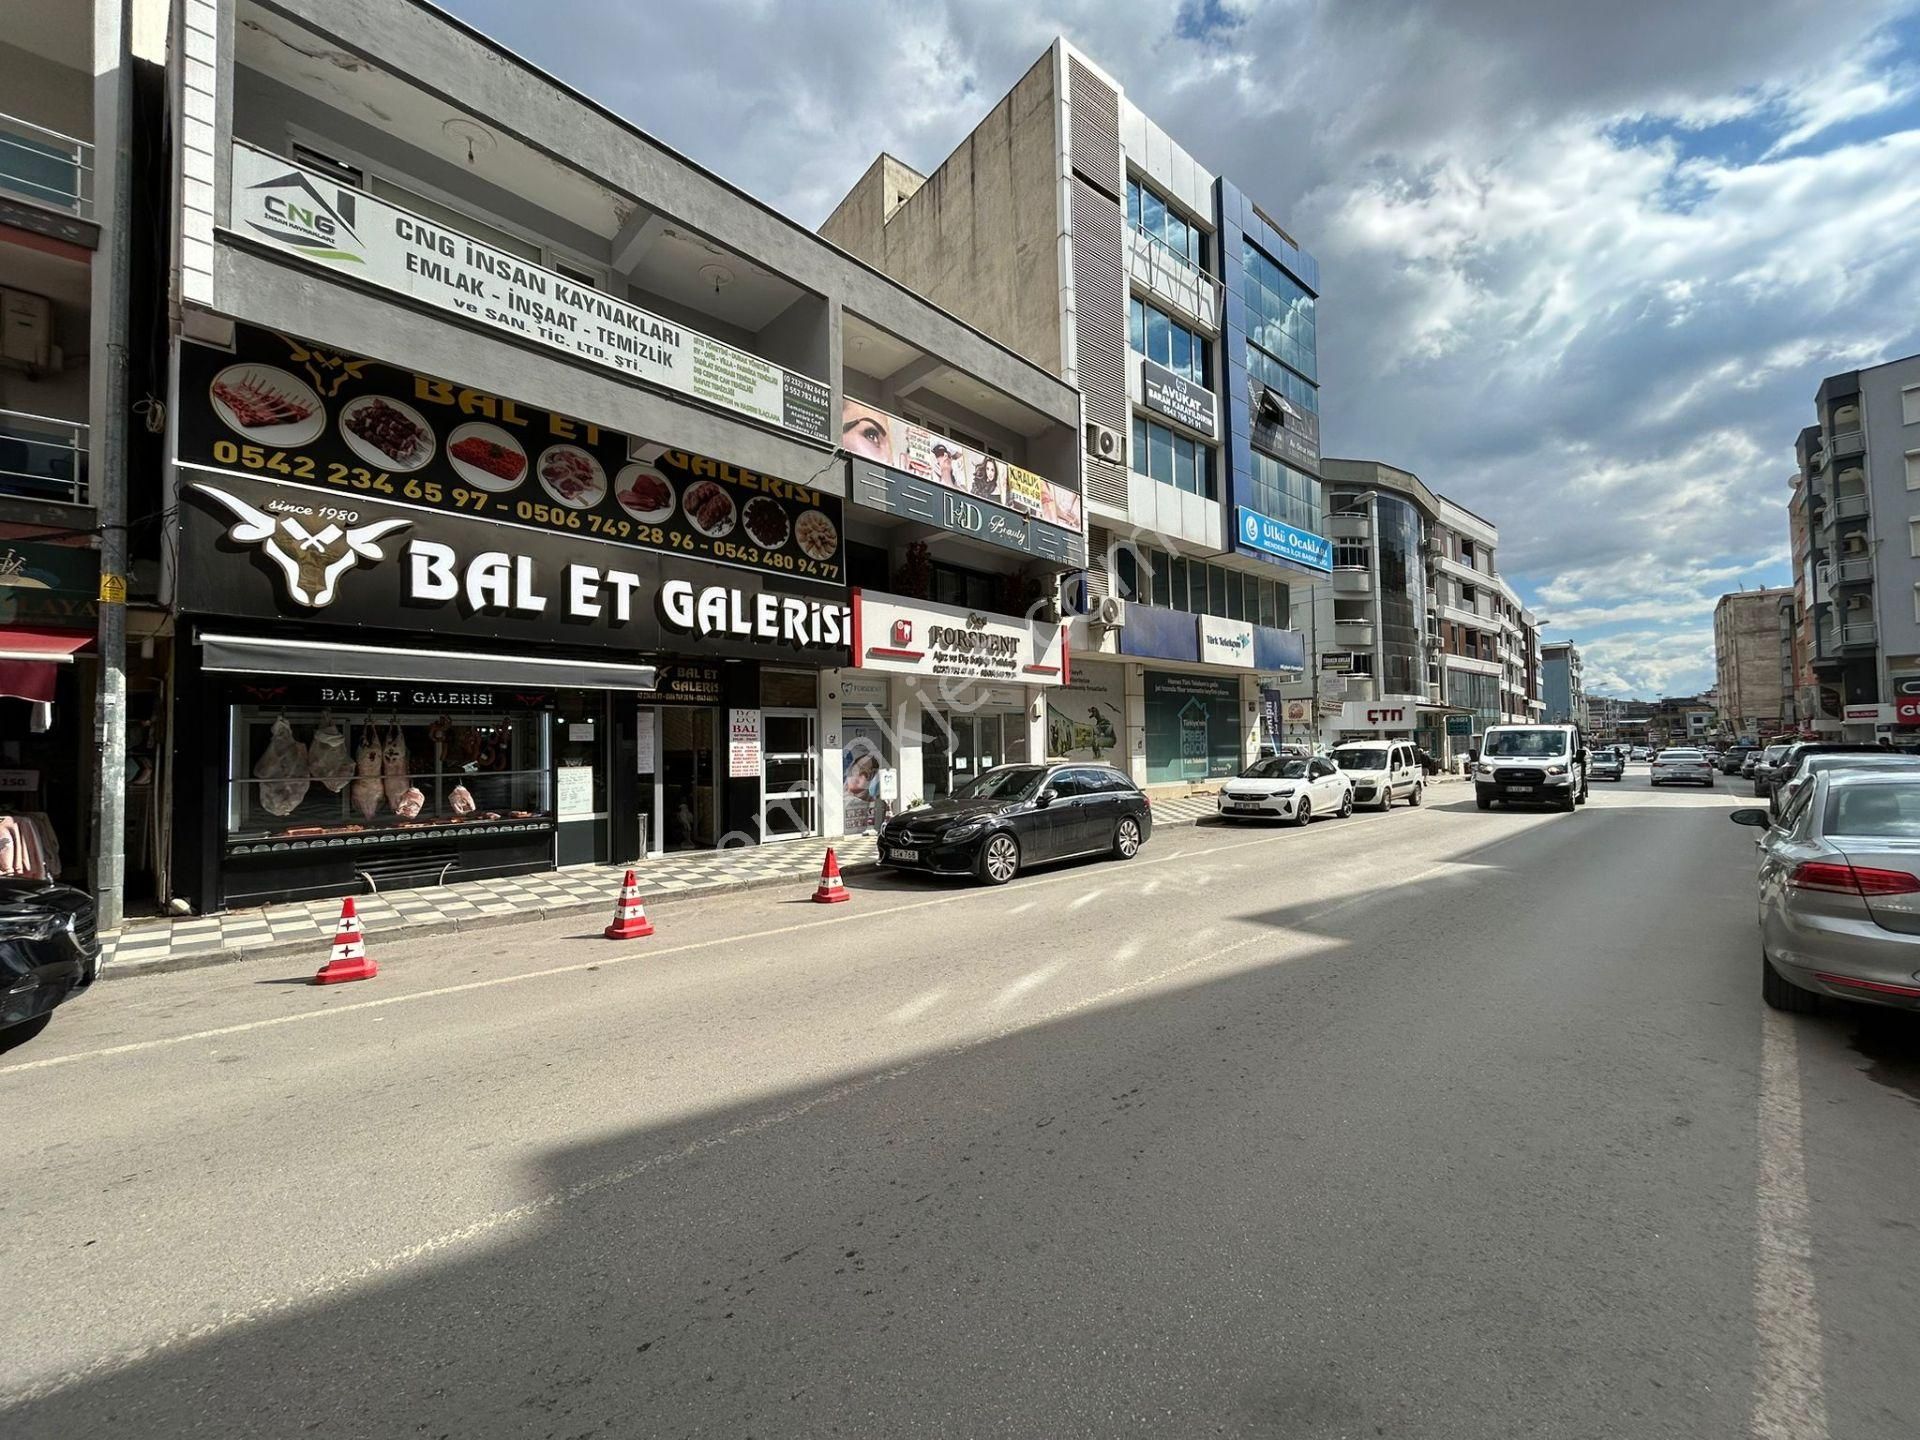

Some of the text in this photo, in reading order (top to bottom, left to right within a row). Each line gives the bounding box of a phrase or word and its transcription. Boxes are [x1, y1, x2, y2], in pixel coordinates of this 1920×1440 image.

[264, 195, 336, 236] CNG
[395, 217, 680, 348] CNG İNSAN KAYNAKLARI
[406, 252, 484, 299] EMLAK
[508, 287, 577, 332] İNŞAAT
[597, 326, 673, 369] TEMİZLİK
[453, 298, 478, 313] ve
[485, 307, 532, 333] SAN.
[577, 342, 608, 361] LTD.
[615, 354, 643, 373] ŞTİ.
[413, 375, 528, 425] BAL
[550, 415, 599, 446] ET
[1162, 384, 1201, 411] AVUKAT
[213, 441, 315, 478] 0542
[327, 463, 394, 493] 234
[403, 480, 442, 502] 65
[452, 488, 488, 510] 97
[516, 501, 580, 529] 0506
[587, 515, 631, 538] 749
[638, 525, 663, 544] 28
[670, 531, 694, 550] 96
[713, 540, 758, 562] 0543
[763, 551, 793, 569] 480
[798, 559, 817, 574] 94
[820, 564, 838, 579] 77
[268, 500, 358, 522] since 1980
[988, 515, 1026, 545] Beauty
[1263, 520, 1286, 542] Ülkü
[410, 540, 547, 611] BAL
[569, 563, 640, 621] ET
[929, 626, 1020, 653] FORSDENT
[1207, 635, 1241, 648] Türk Telekom
[677, 667, 718, 680] BAL ET
[322, 688, 493, 705] BAL ET GALERISI
[731, 725, 758, 733] BAL
